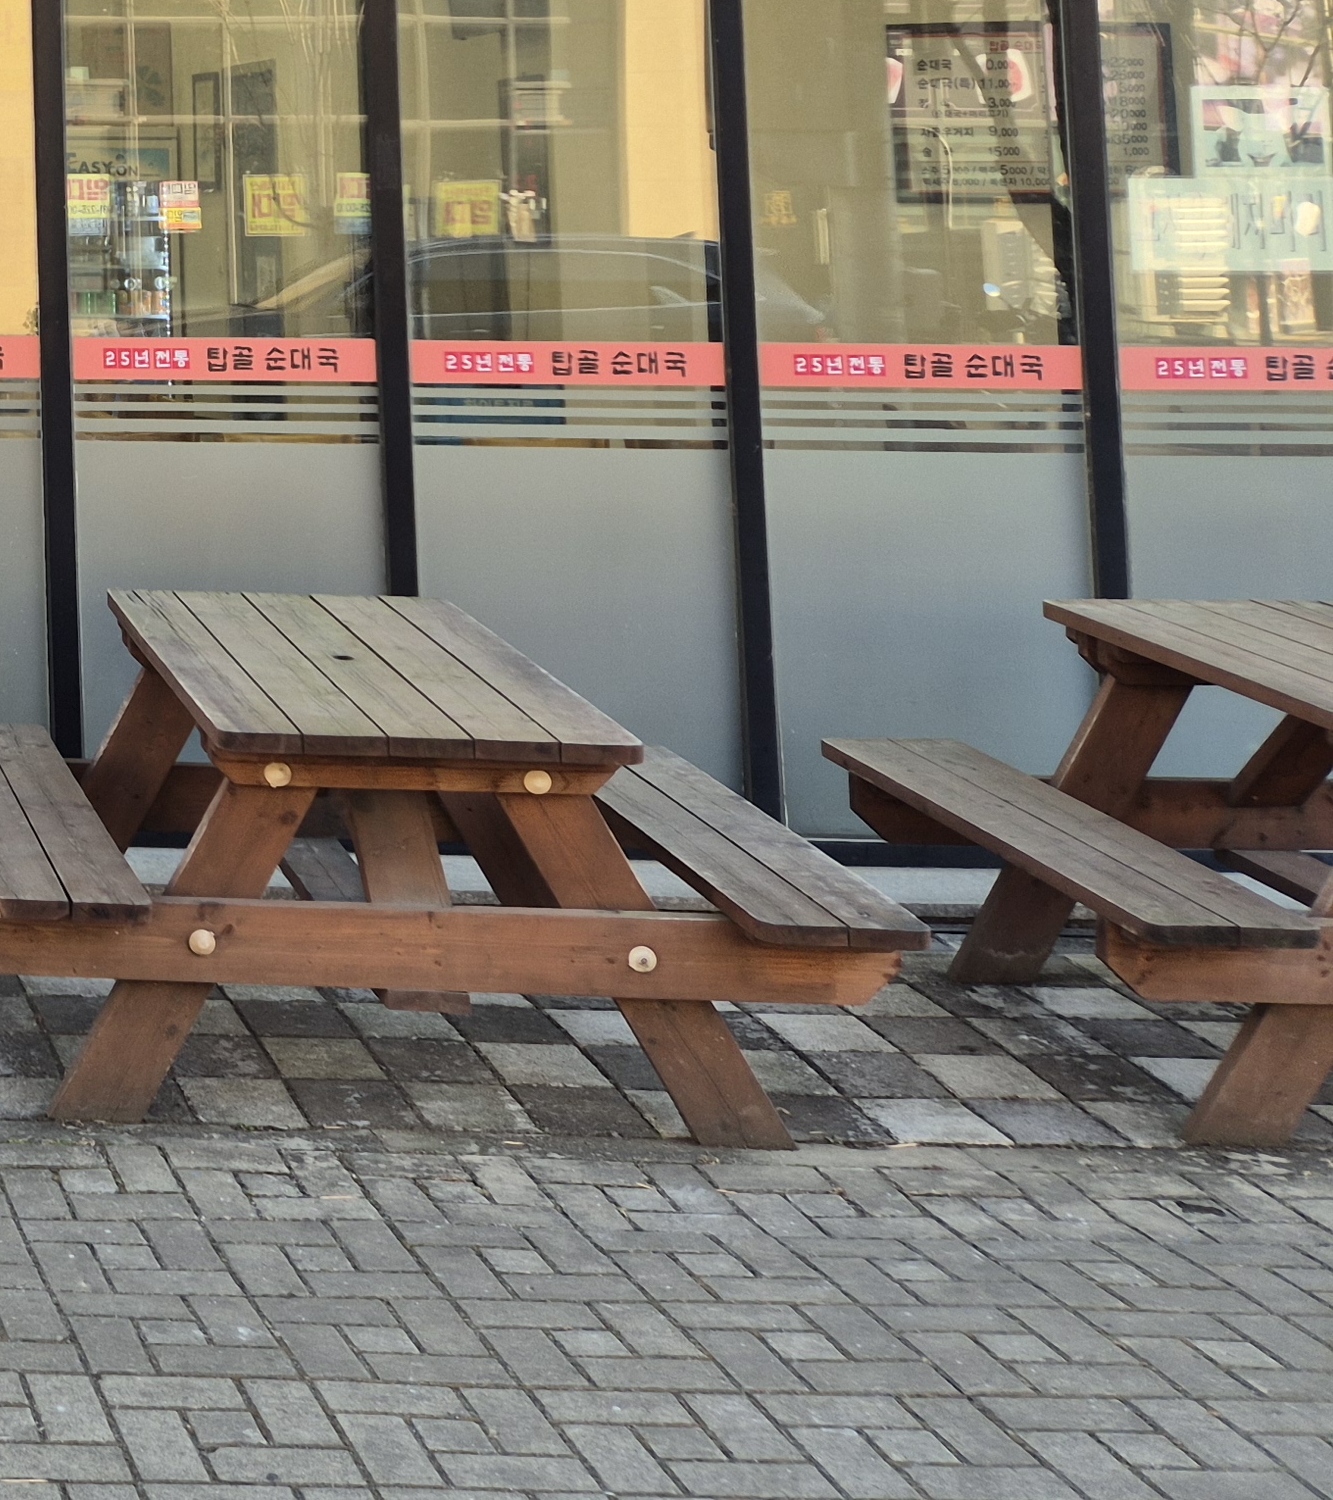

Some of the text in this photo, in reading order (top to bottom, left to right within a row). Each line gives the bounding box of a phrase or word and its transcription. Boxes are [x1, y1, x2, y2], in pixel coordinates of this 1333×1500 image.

[105, 349, 150, 368] 25년
[206, 345, 254, 372] 탑골
[264, 346, 340, 373] 순대국
[445, 354, 492, 371] 25년
[551, 350, 600, 376] 탑골
[610, 350, 687, 377] 순대국
[795, 356, 843, 375] 25년
[903, 352, 954, 379] 탑골
[964, 353, 1044, 381] 순대국
[1157, 359, 1205, 378] 25년
[1265, 354, 1316, 382] 탑골
